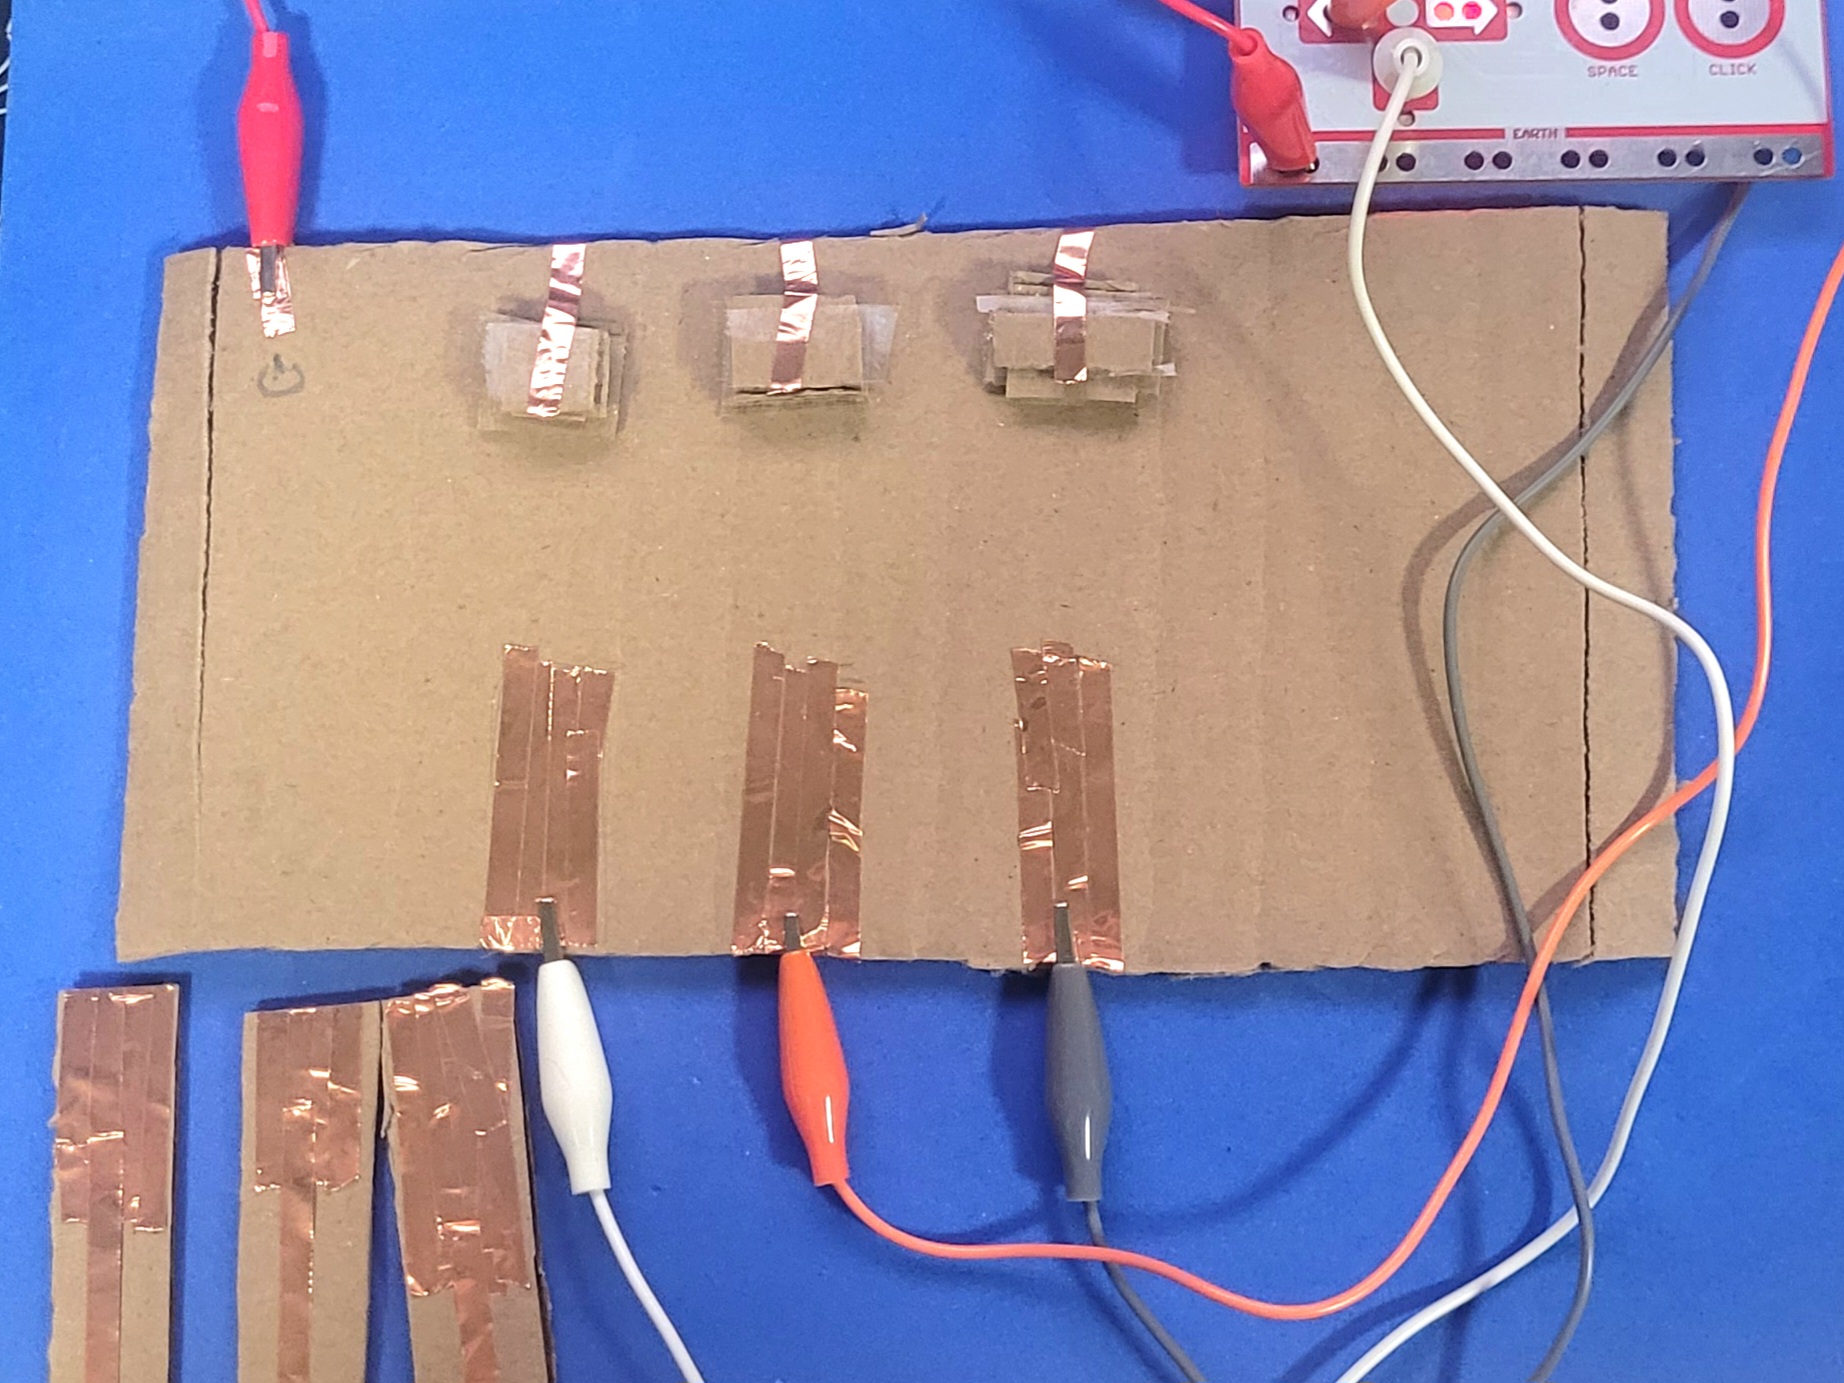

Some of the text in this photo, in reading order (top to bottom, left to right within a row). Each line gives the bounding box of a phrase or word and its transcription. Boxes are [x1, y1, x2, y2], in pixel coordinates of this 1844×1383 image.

[1587, 64, 1639, 78] SPACE
[1708, 62, 1757, 76] CLICK
[1512, 127, 1559, 140] EARTH
